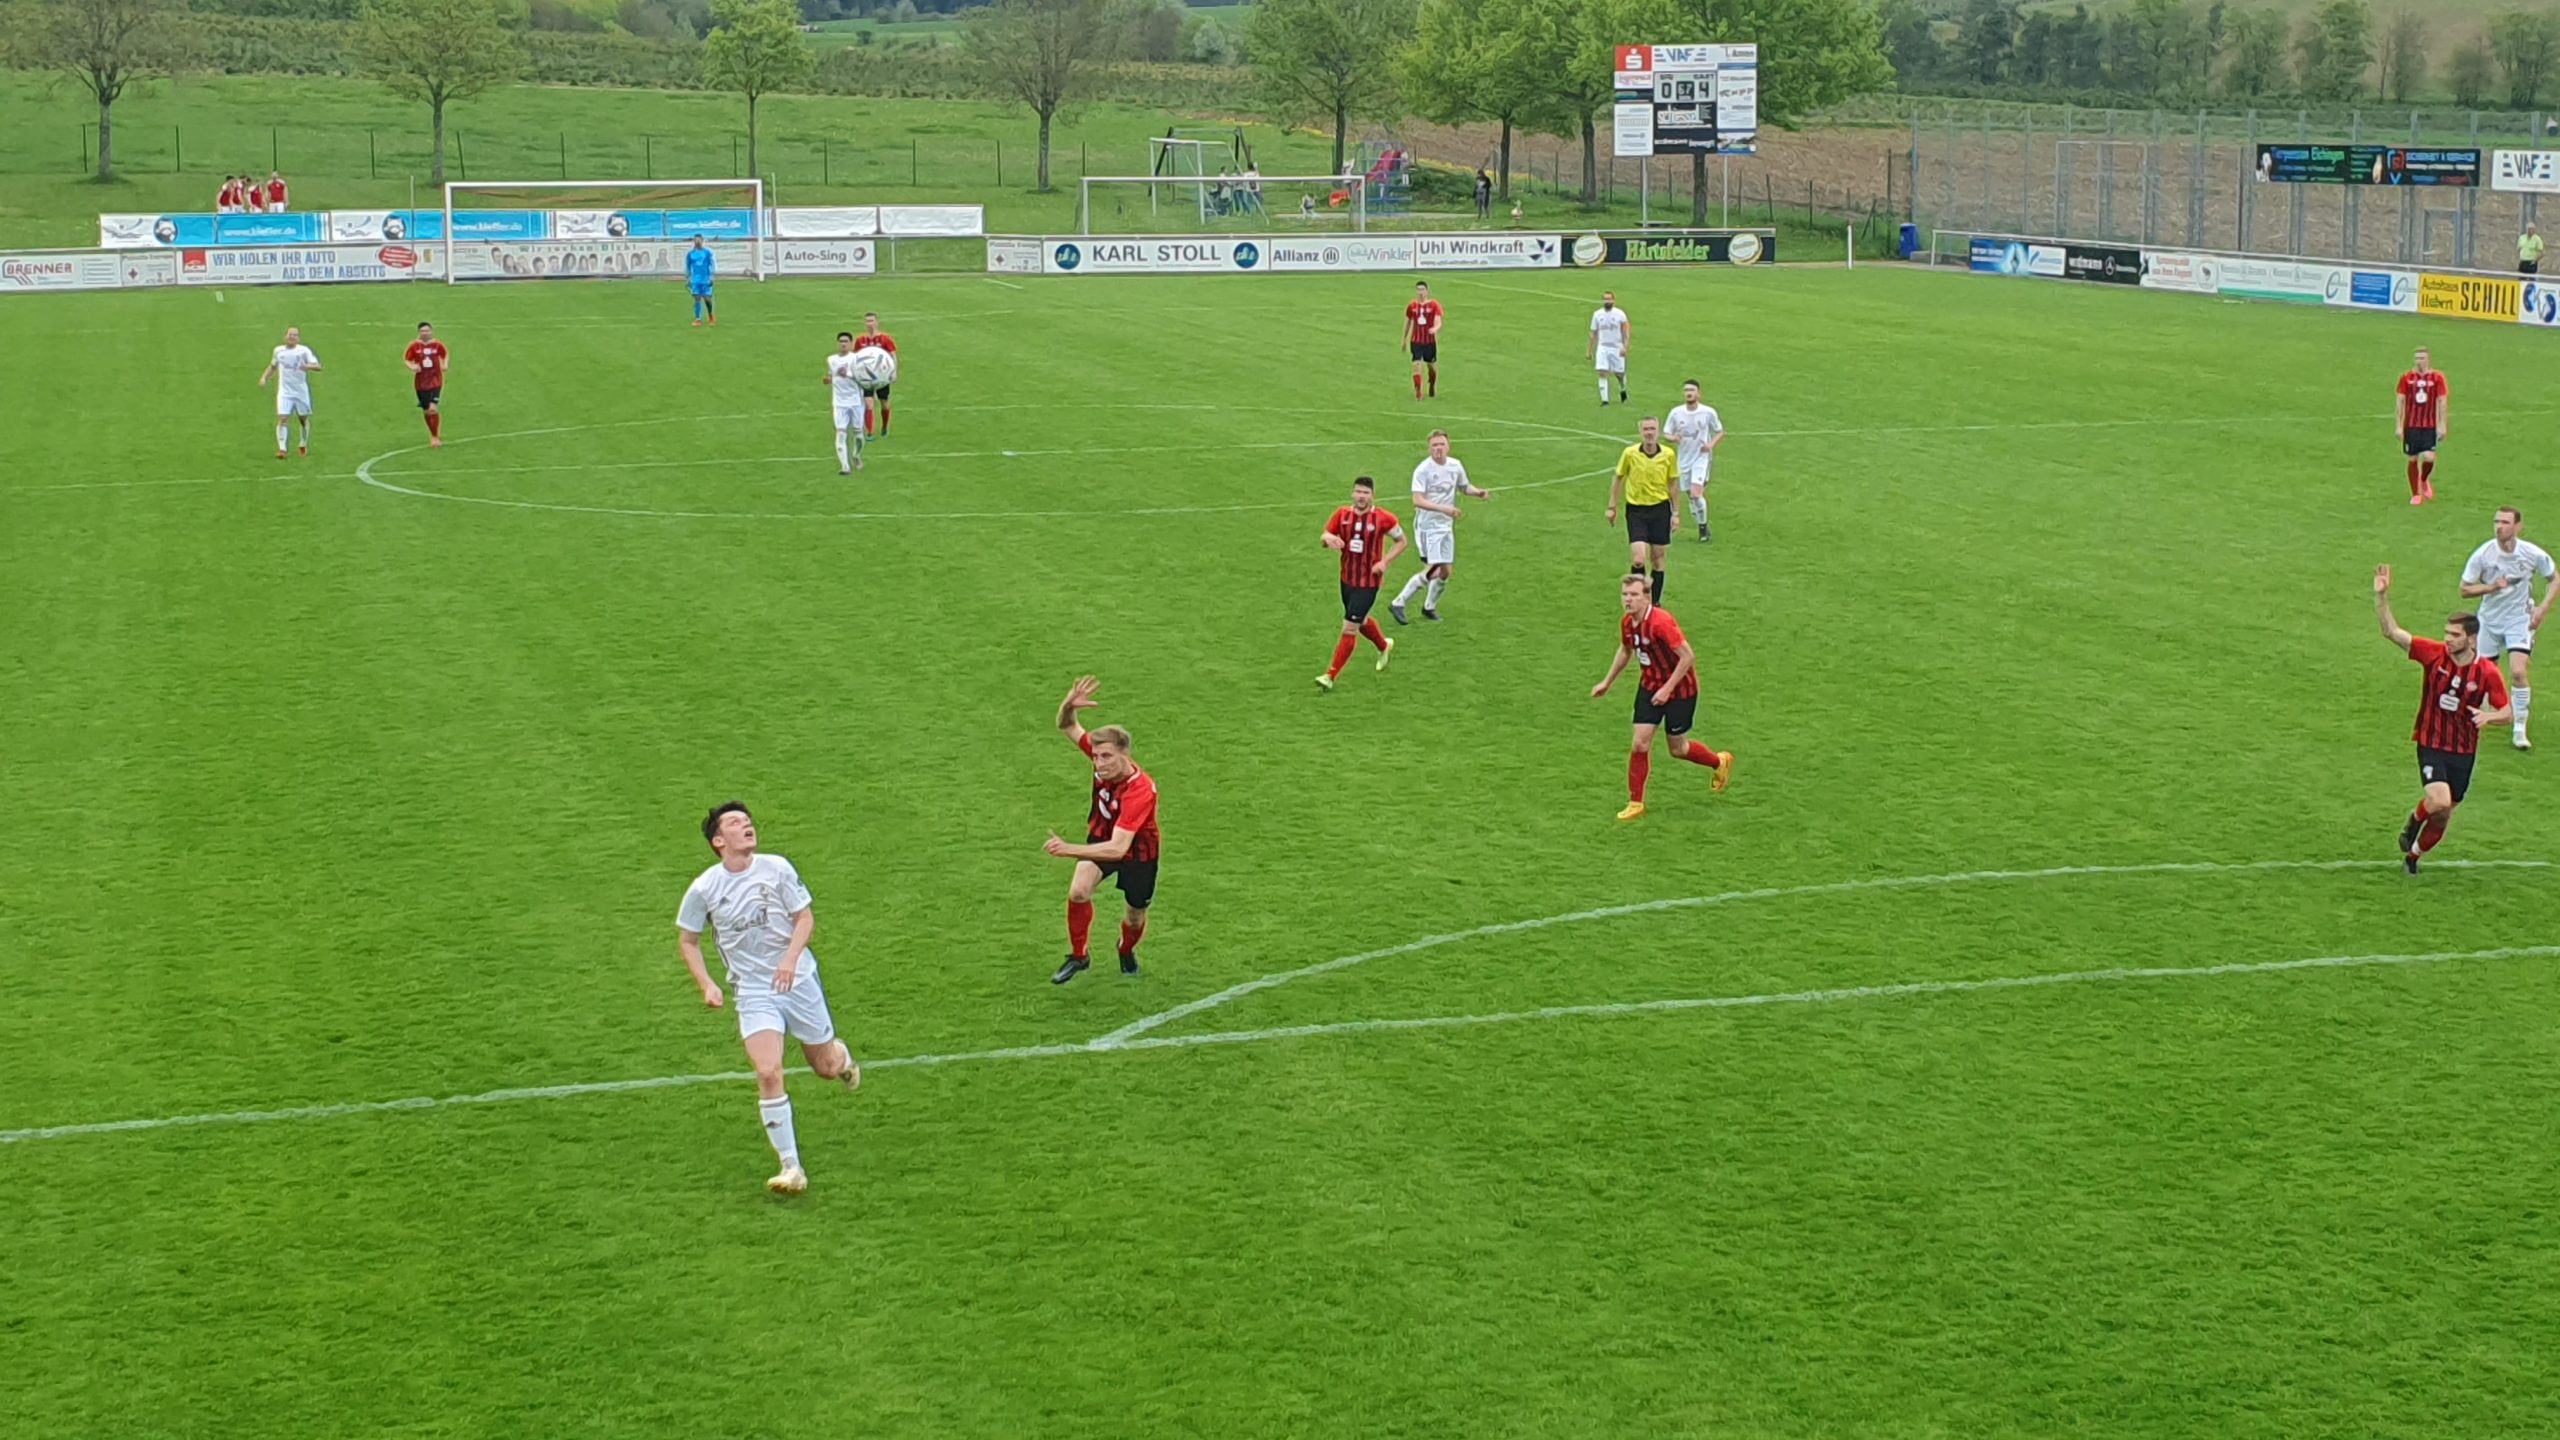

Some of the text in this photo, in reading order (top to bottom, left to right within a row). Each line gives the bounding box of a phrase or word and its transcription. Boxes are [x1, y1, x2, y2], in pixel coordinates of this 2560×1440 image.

[1092, 244, 1222, 262] KARL STOLL
[1419, 239, 1525, 255] Uhl Windkraft
[213, 250, 336, 266] WIR HOLEN IHR AUTO
[784, 249, 848, 263] Auto-Sing
[1273, 249, 1320, 262] Allianz
[6, 262, 73, 275] BRENNER
[281, 266, 306, 279] AUS
[309, 265, 335, 279] DEM
[338, 264, 386, 278] ABSEITS
[2460, 281, 2517, 316] SCHILL
